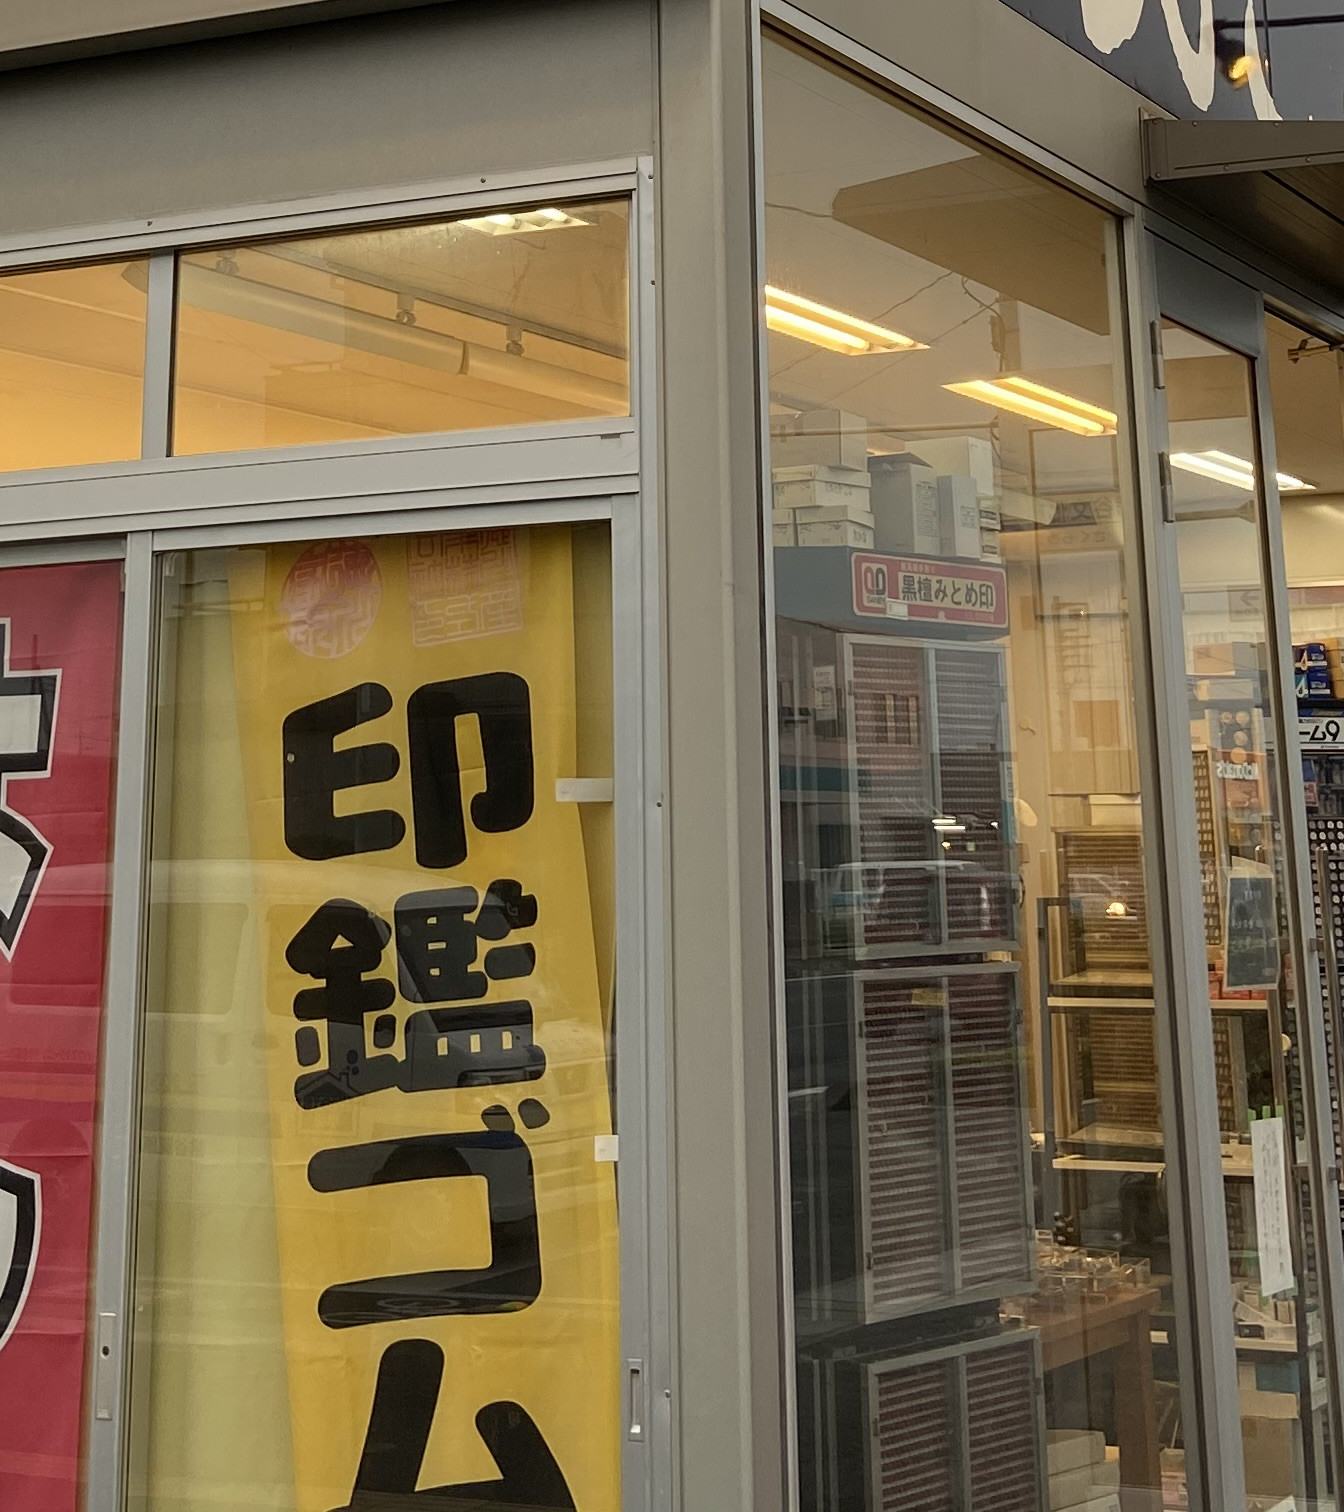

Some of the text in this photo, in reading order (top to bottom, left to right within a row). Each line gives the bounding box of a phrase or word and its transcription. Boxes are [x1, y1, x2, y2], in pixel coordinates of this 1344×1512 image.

[901, 573, 995, 610] 黒檀みとめ印
[279, 671, 578, 1512] 印鑑ゴム
